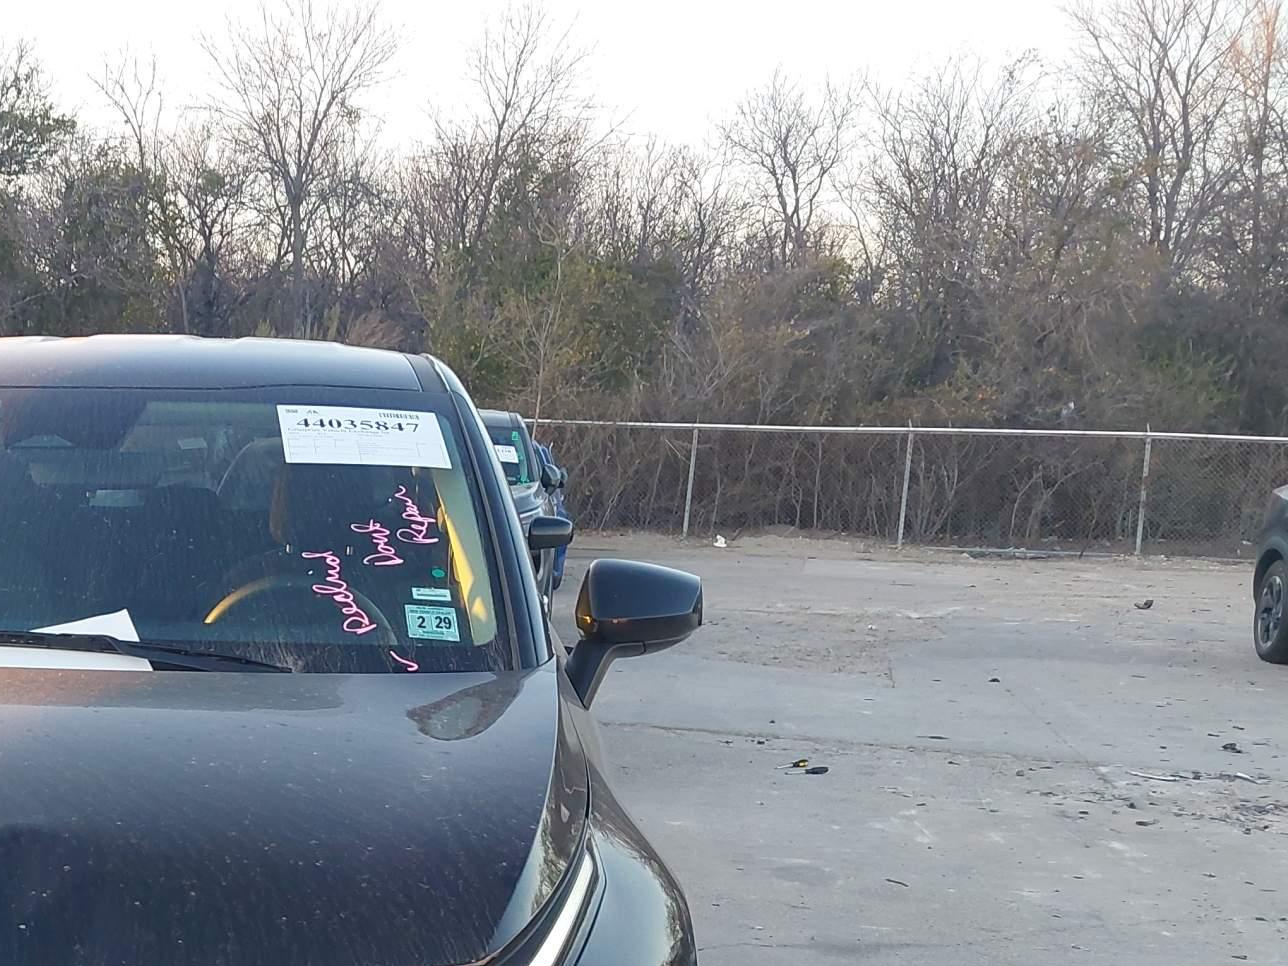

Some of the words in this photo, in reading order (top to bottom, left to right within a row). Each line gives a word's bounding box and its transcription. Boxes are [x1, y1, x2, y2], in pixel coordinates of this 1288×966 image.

[296, 417, 419, 433] 44035847
[416, 615, 427, 629] 2
[434, 615, 452, 630] 29
